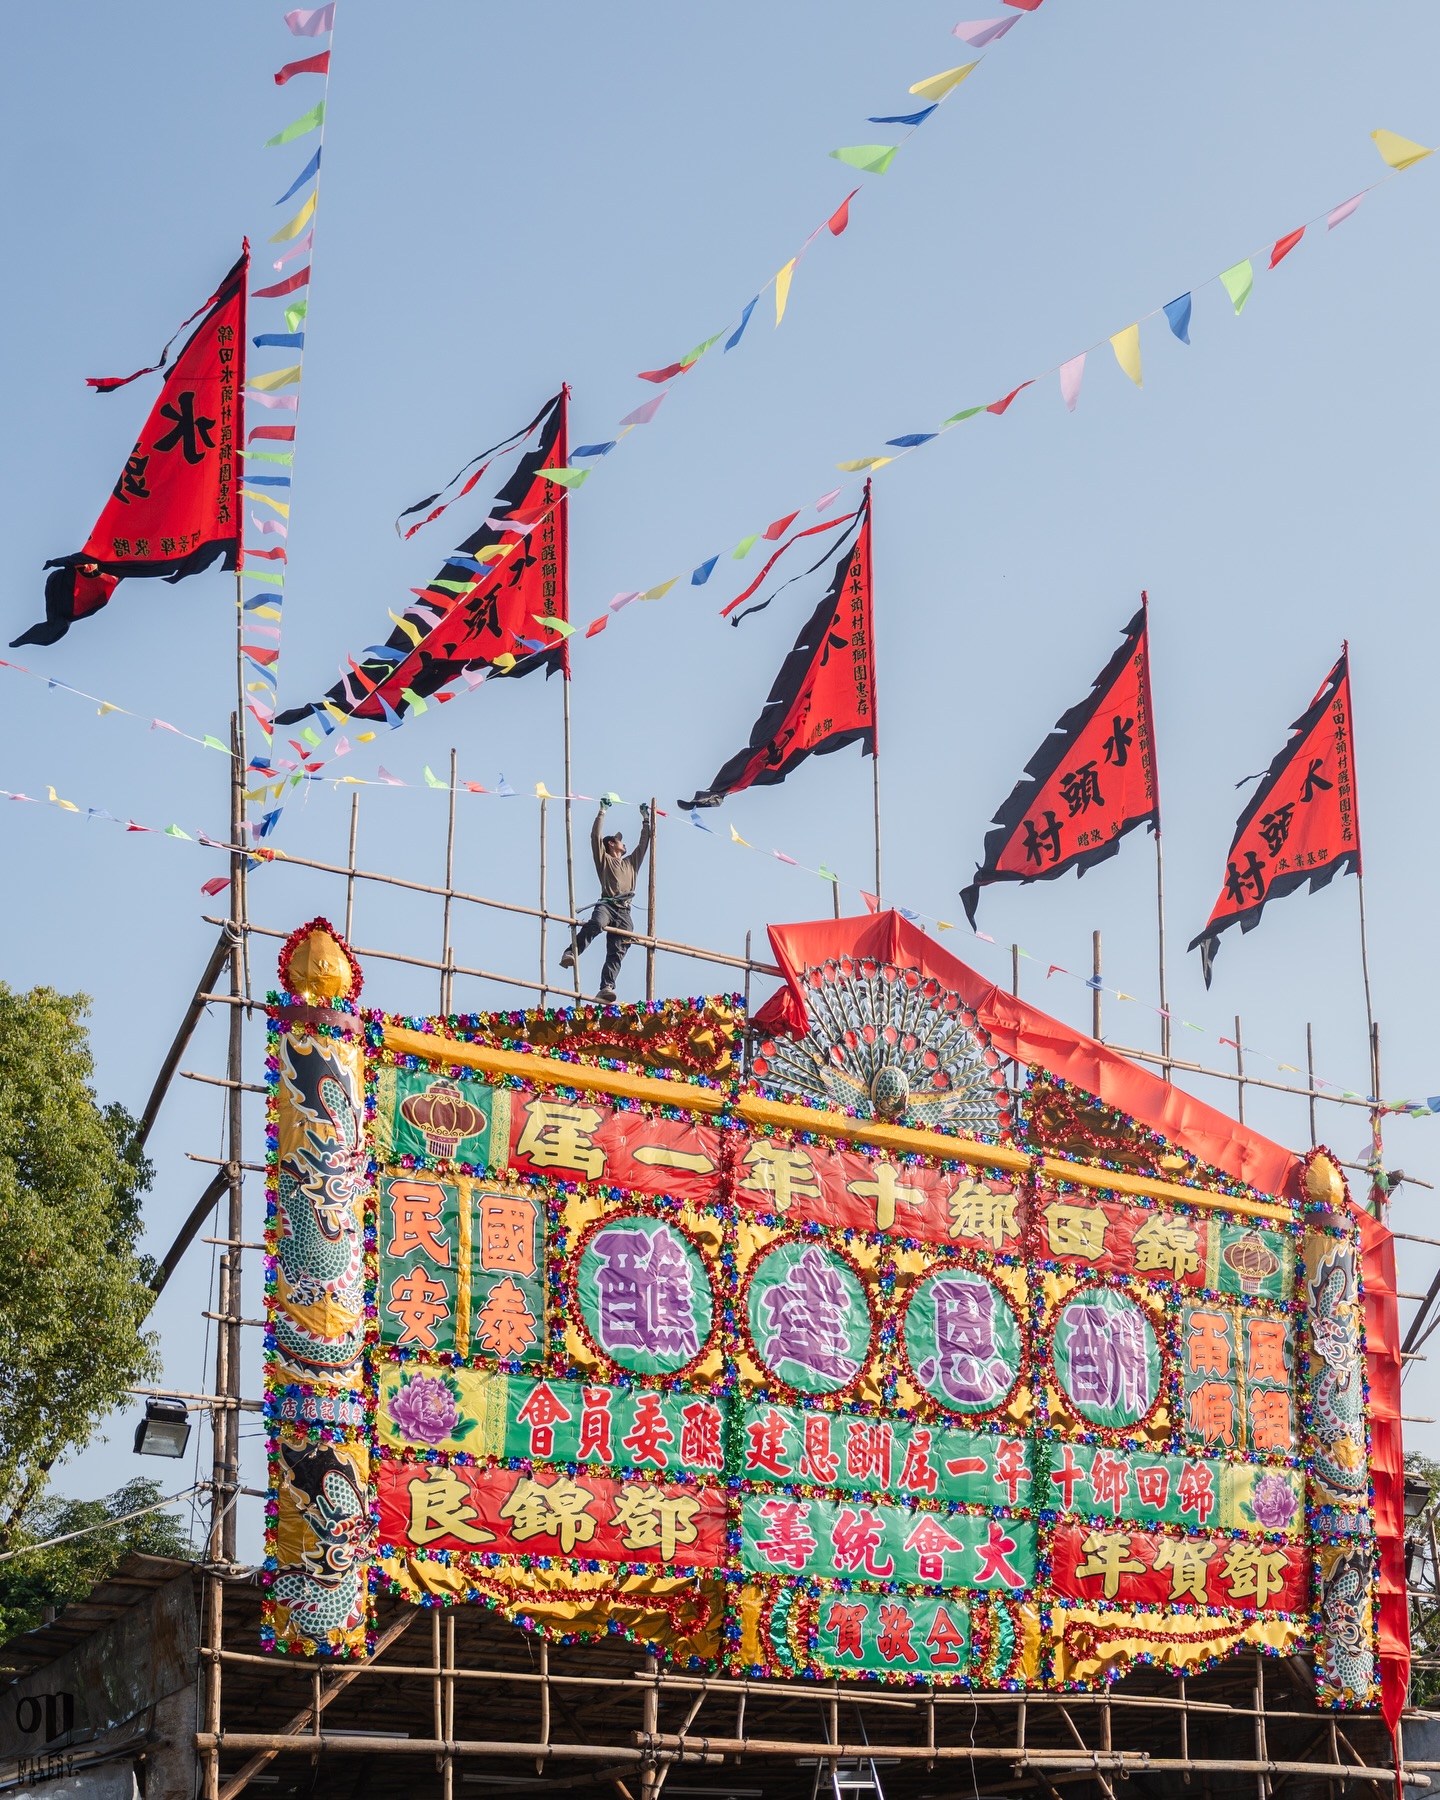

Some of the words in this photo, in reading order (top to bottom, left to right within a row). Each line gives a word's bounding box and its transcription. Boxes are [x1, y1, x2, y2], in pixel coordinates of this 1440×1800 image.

[541, 457, 557, 635] 水頭村醒獅團惠
[1022, 714, 1135, 867] 水頭村
[406, 1465, 701, 1562] 鄧錦良
[754, 1499, 1026, 1589] 大會統籌
[1075, 1530, 1289, 1609] 鄧賀年
